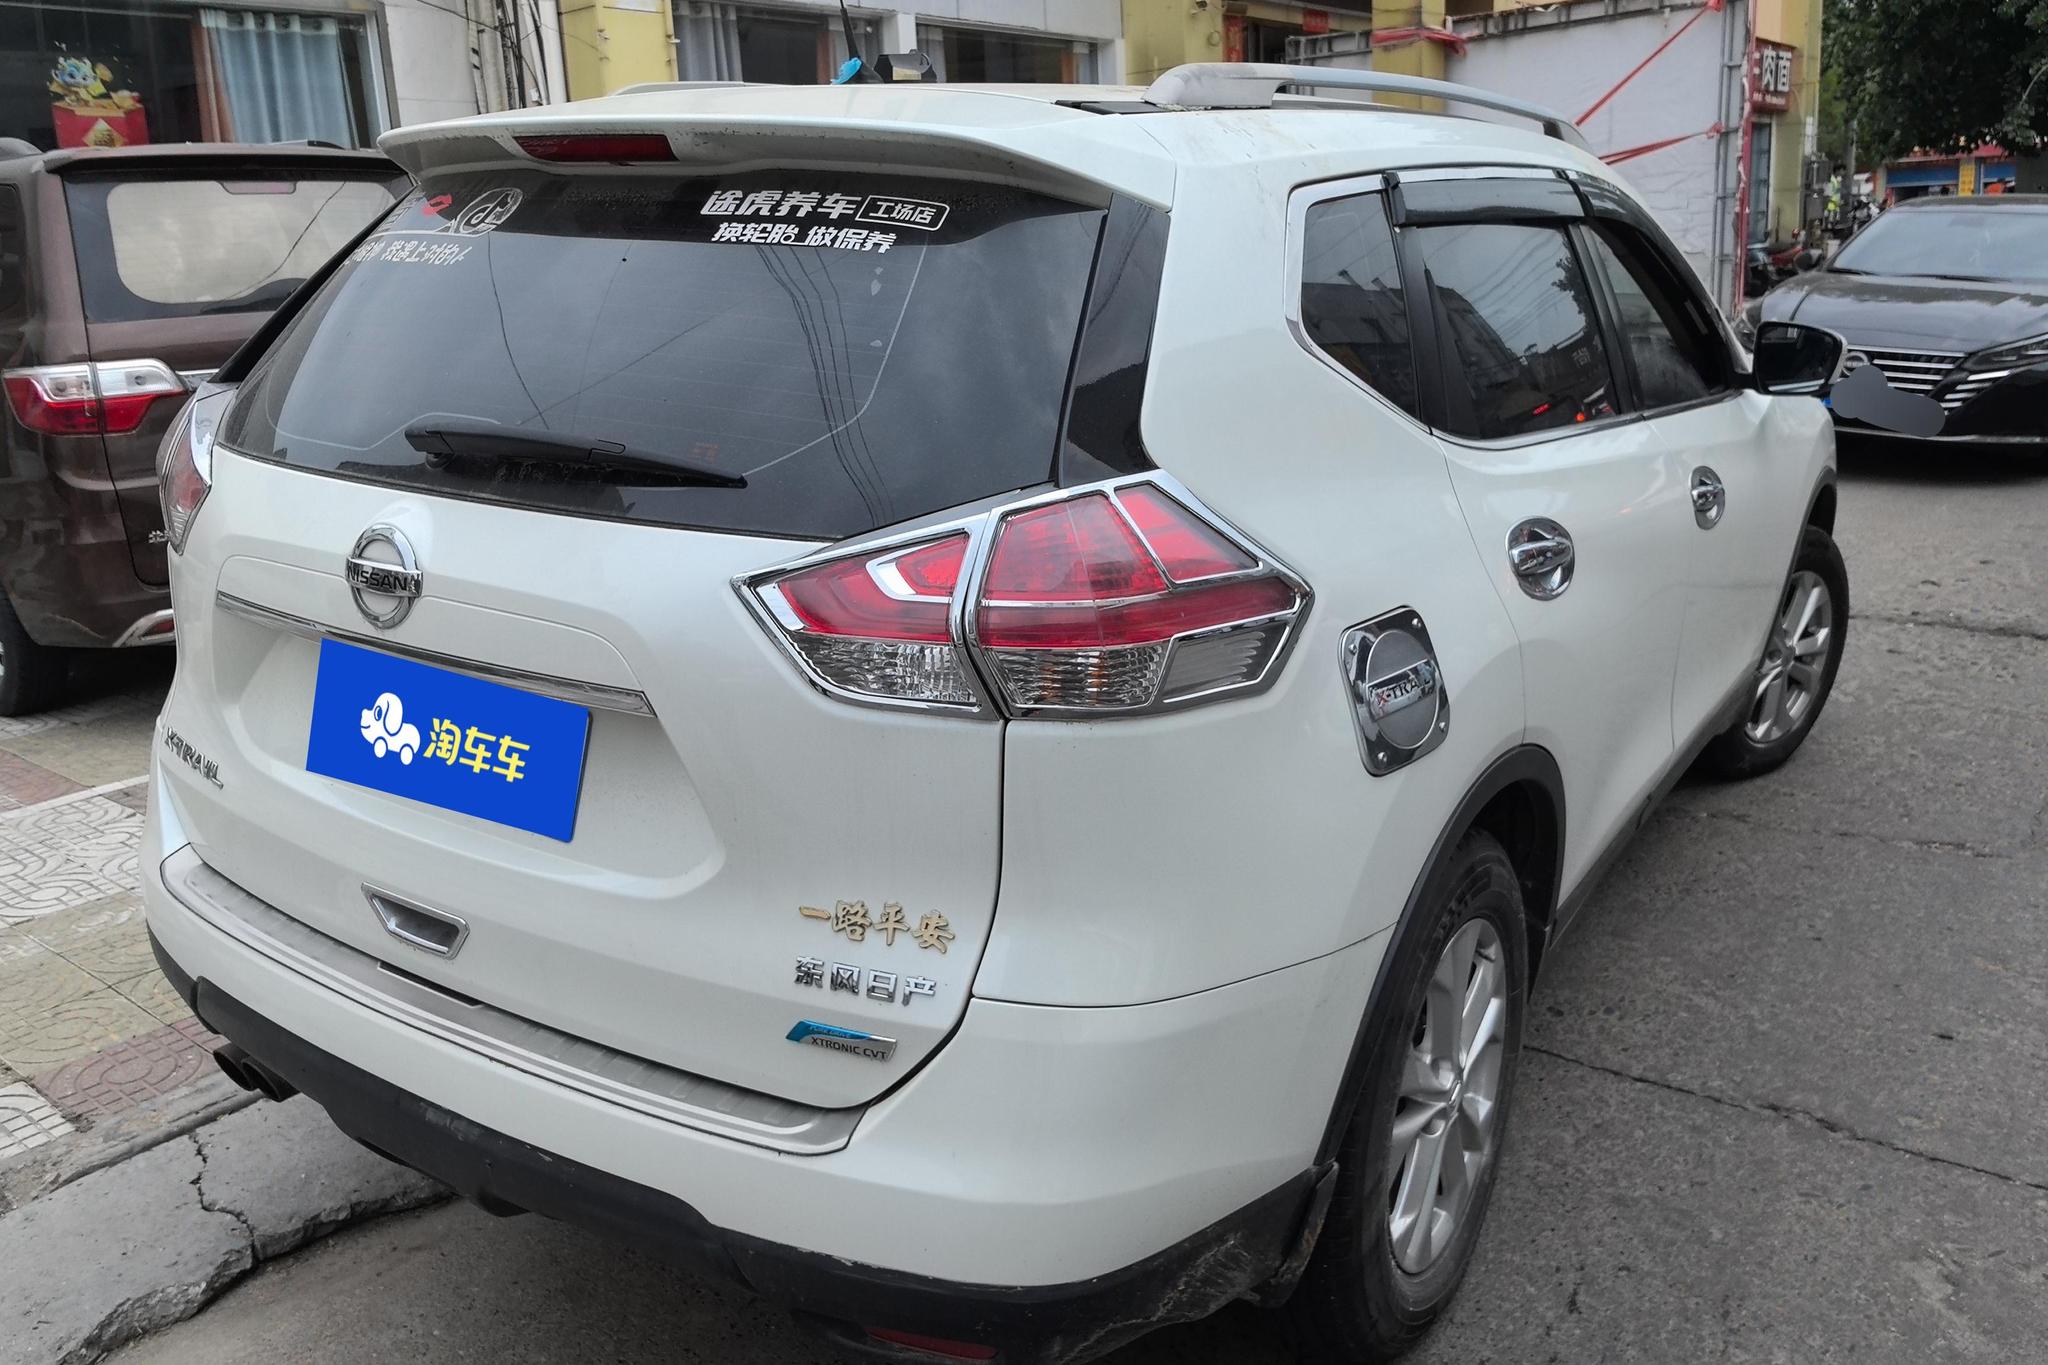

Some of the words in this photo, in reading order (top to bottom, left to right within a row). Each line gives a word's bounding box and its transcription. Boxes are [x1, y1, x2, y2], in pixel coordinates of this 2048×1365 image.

[699, 190, 862, 219] 途虎养车
[869, 201, 937, 224] 工场店
[711, 222, 799, 246] 换轮胎
[806, 226, 897, 254] 做保养
[346, 560, 408, 592] NISSAN
[1375, 678, 1431, 706] X-TRAL
[799, 899, 956, 954] 一路平安
[794, 955, 937, 1006] 东风日产
[811, 1036, 861, 1055] XTRONIC
[863, 1046, 888, 1061] CVT
